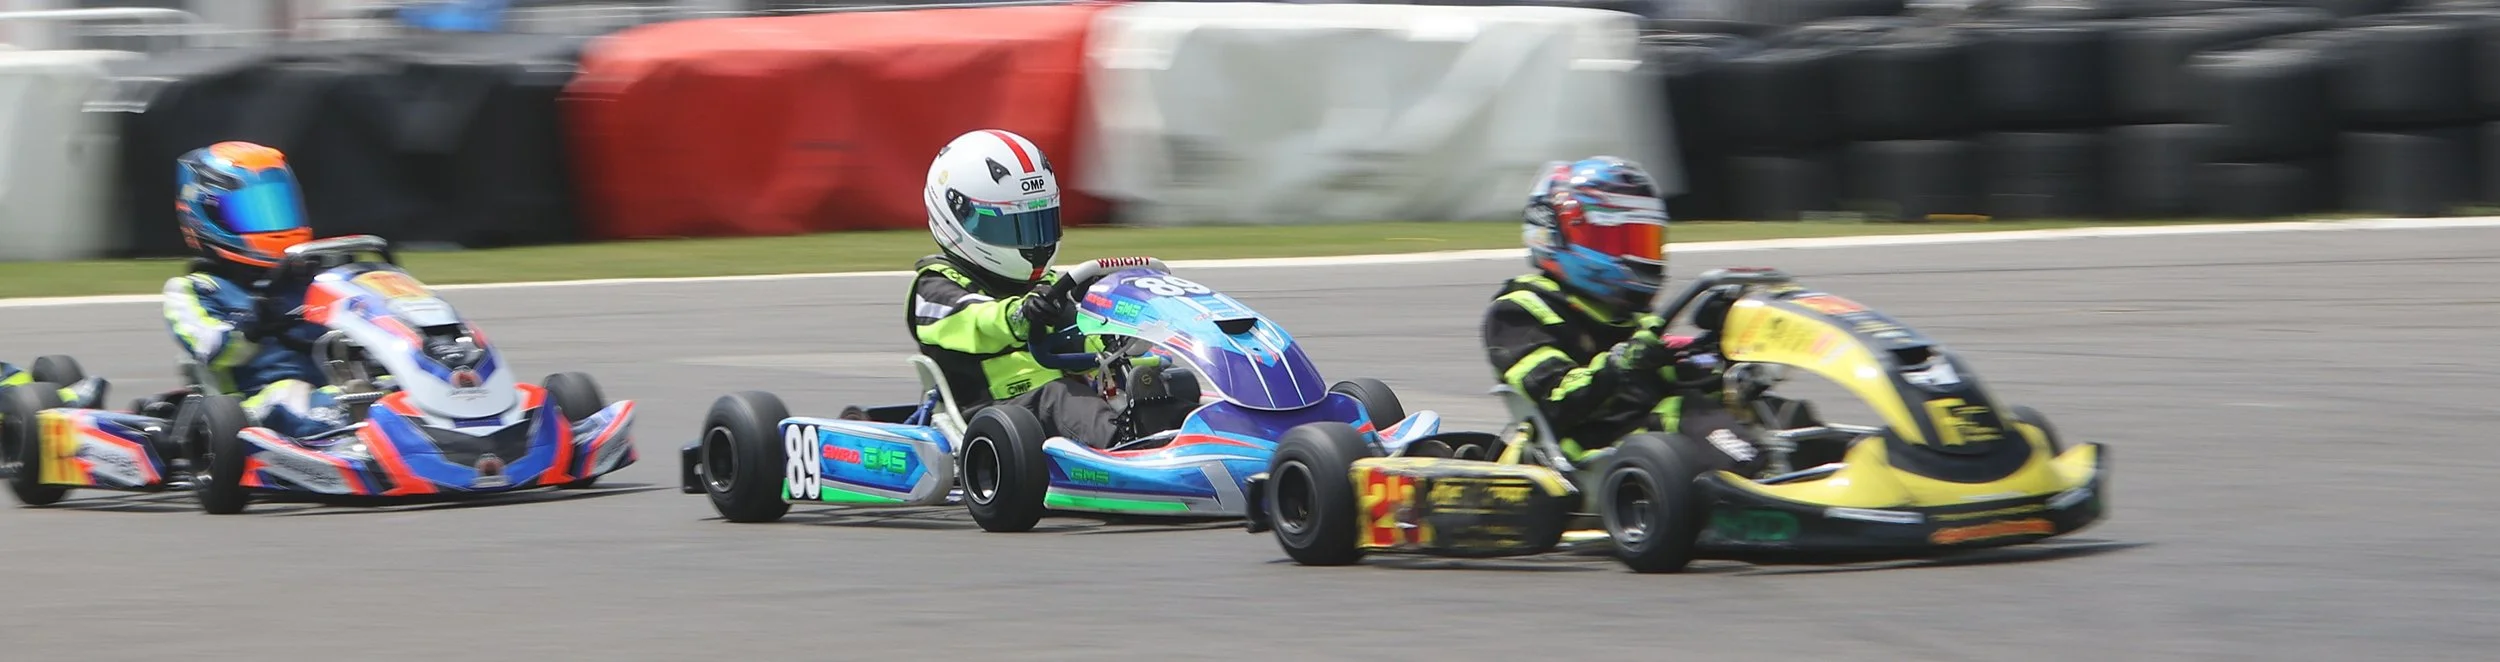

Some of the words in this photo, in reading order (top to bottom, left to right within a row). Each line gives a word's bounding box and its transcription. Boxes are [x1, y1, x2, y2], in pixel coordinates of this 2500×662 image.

[1021, 178, 1045, 192] OMP
[1097, 256, 1151, 269] WRIGHT
[1134, 275, 1211, 297] 89
[1114, 299, 1143, 319] GMS
[784, 424, 821, 500] 89
[863, 446, 907, 475] GMS
[1070, 468, 1109, 484] GMS
